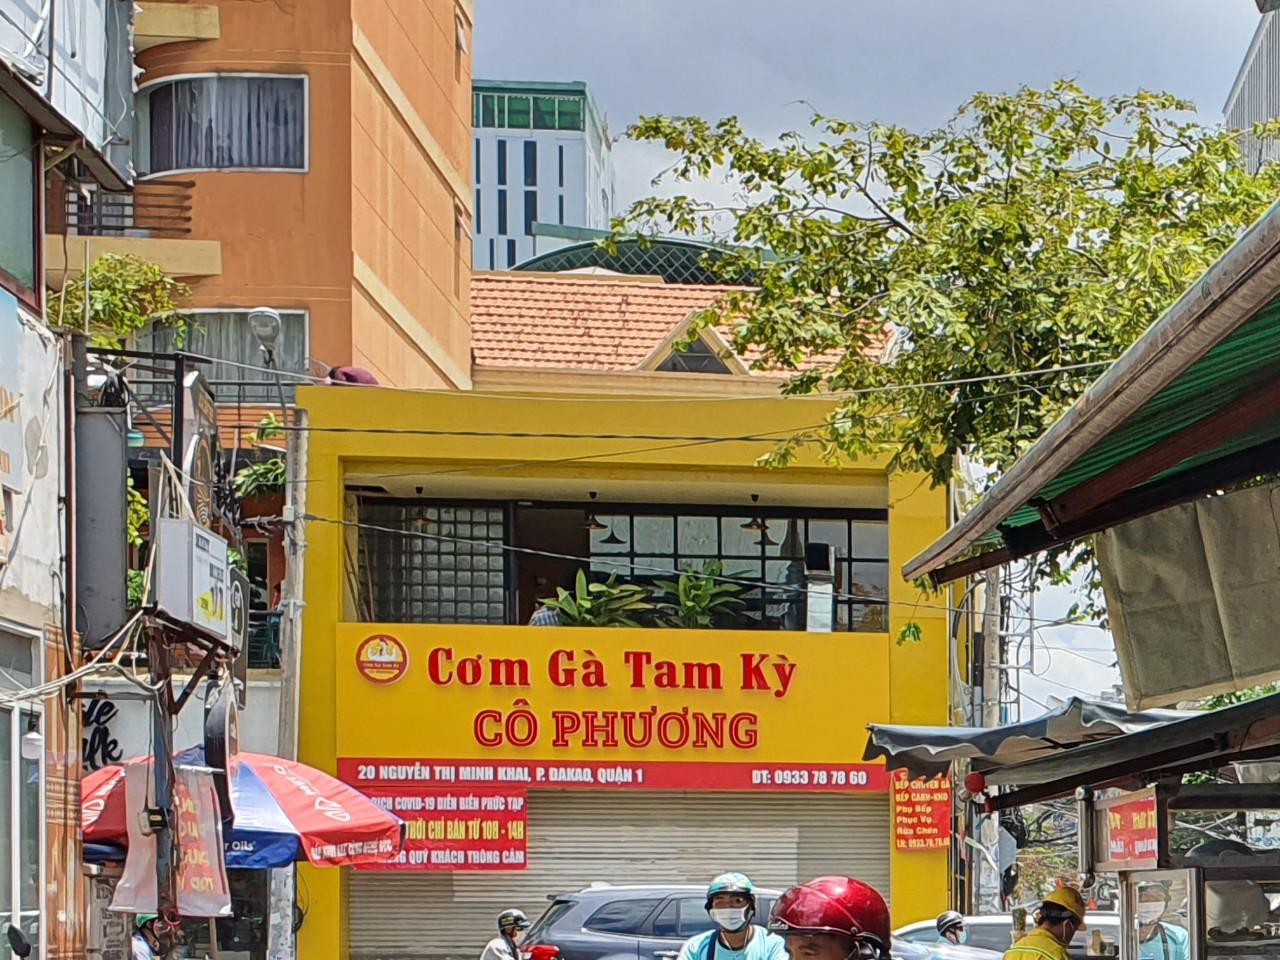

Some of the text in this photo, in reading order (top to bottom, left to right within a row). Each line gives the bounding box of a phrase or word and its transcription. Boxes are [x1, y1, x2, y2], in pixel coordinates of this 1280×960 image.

[427, 647, 797, 698] Cơm Gà Tam Kỳ
[473, 699, 759, 750] CÔ PHƯƠNG
[357, 765, 376, 780] 20
[379, 761, 430, 780] NGUYỄN
[433, 766, 455, 783] THỊ
[459, 766, 494, 780] MINH
[497, 766, 532, 782] KHAI,
[597, 766, 632, 784] QUẬN
[635, 769, 643, 782] 1
[774, 770, 809, 784] 0933
[812, 771, 828, 785] 78
[831, 771, 846, 785] 78
[850, 771, 867, 785] 60
[395, 797, 435, 810] COVID-19
[482, 821, 499, 839] 10H
[508, 821, 524, 839] 14H
[431, 848, 465, 864] KHÁCH
[467, 849, 500, 864] THÔNG
